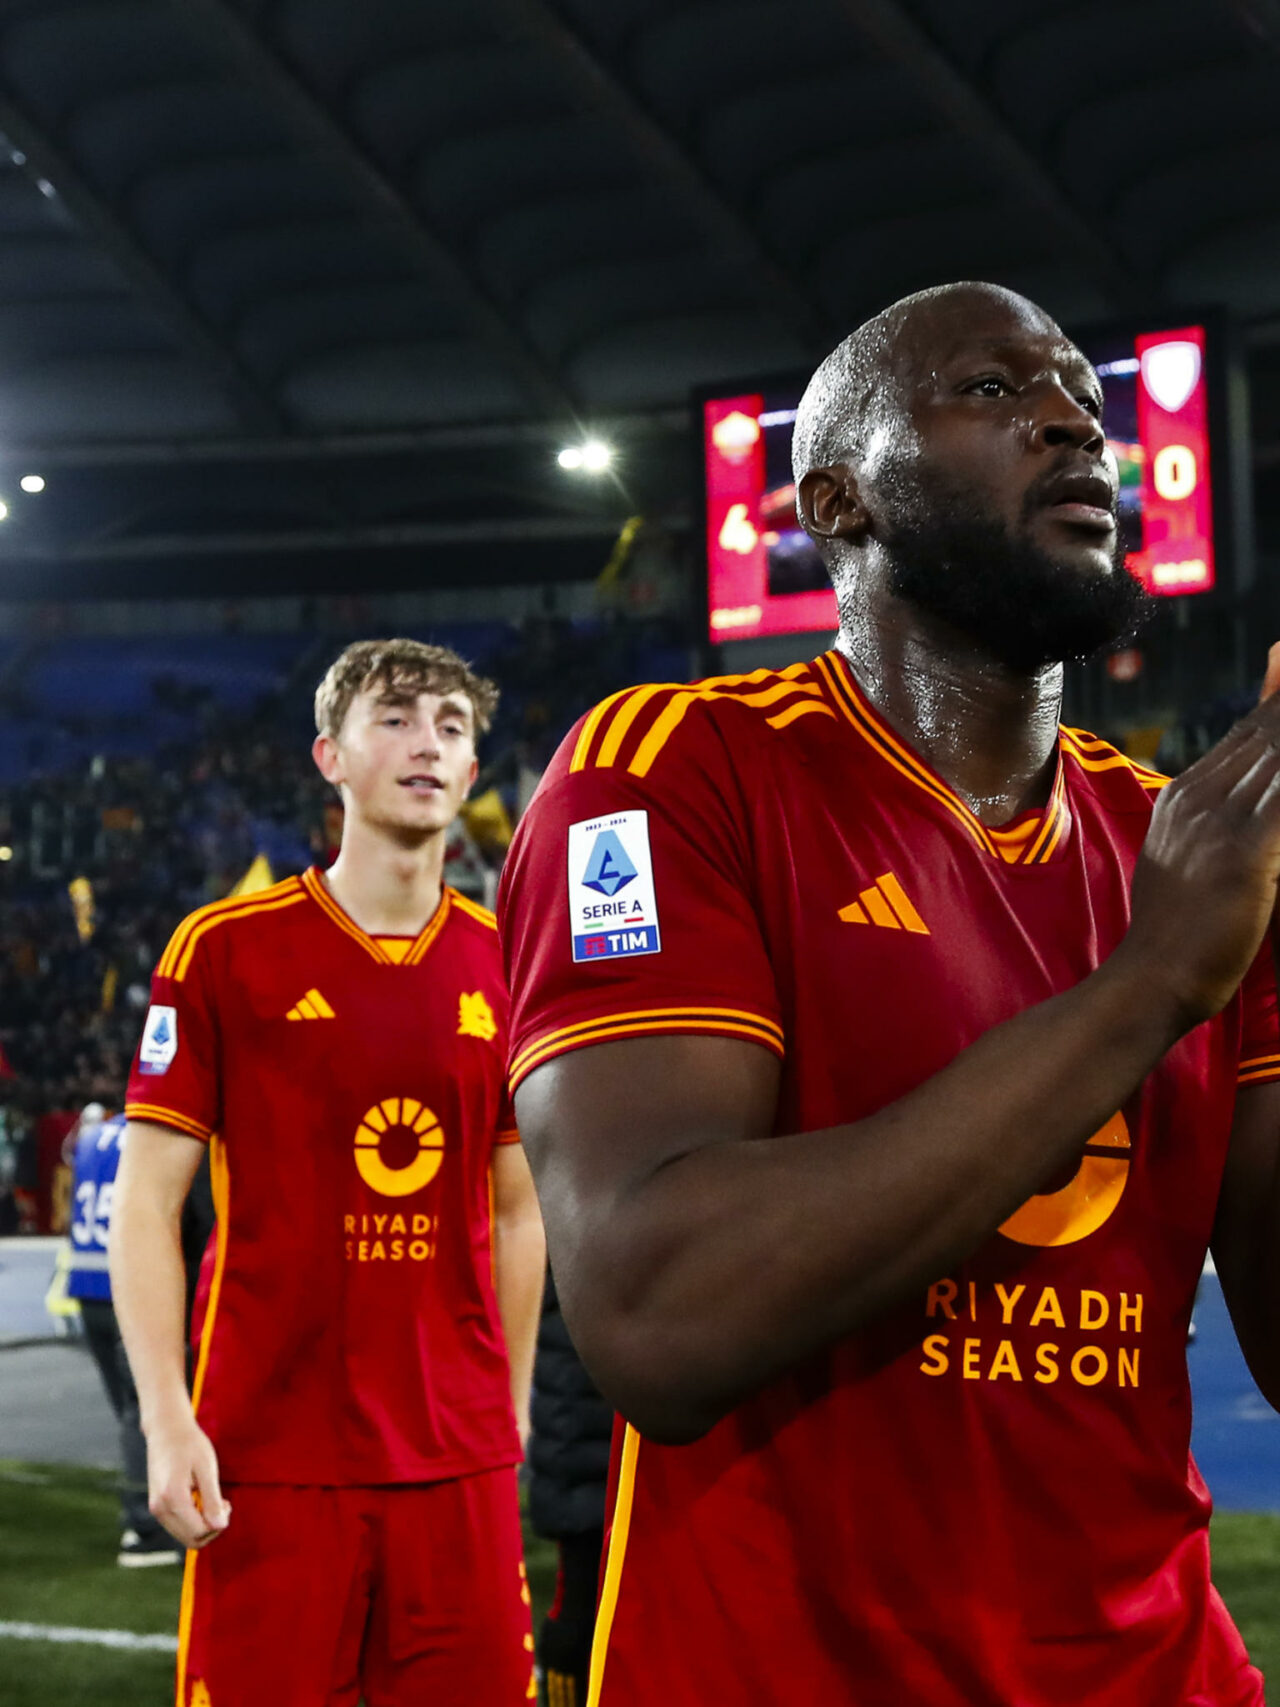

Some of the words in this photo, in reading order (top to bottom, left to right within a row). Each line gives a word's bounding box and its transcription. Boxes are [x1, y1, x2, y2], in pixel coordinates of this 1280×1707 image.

[1154, 445, 1197, 501] 0
[583, 901, 627, 920] SERIE
[632, 899, 643, 912] A
[607, 931, 648, 952] TIM
[925, 1278, 1143, 1332] RIYADH
[920, 1334, 1140, 1387] SEASON
